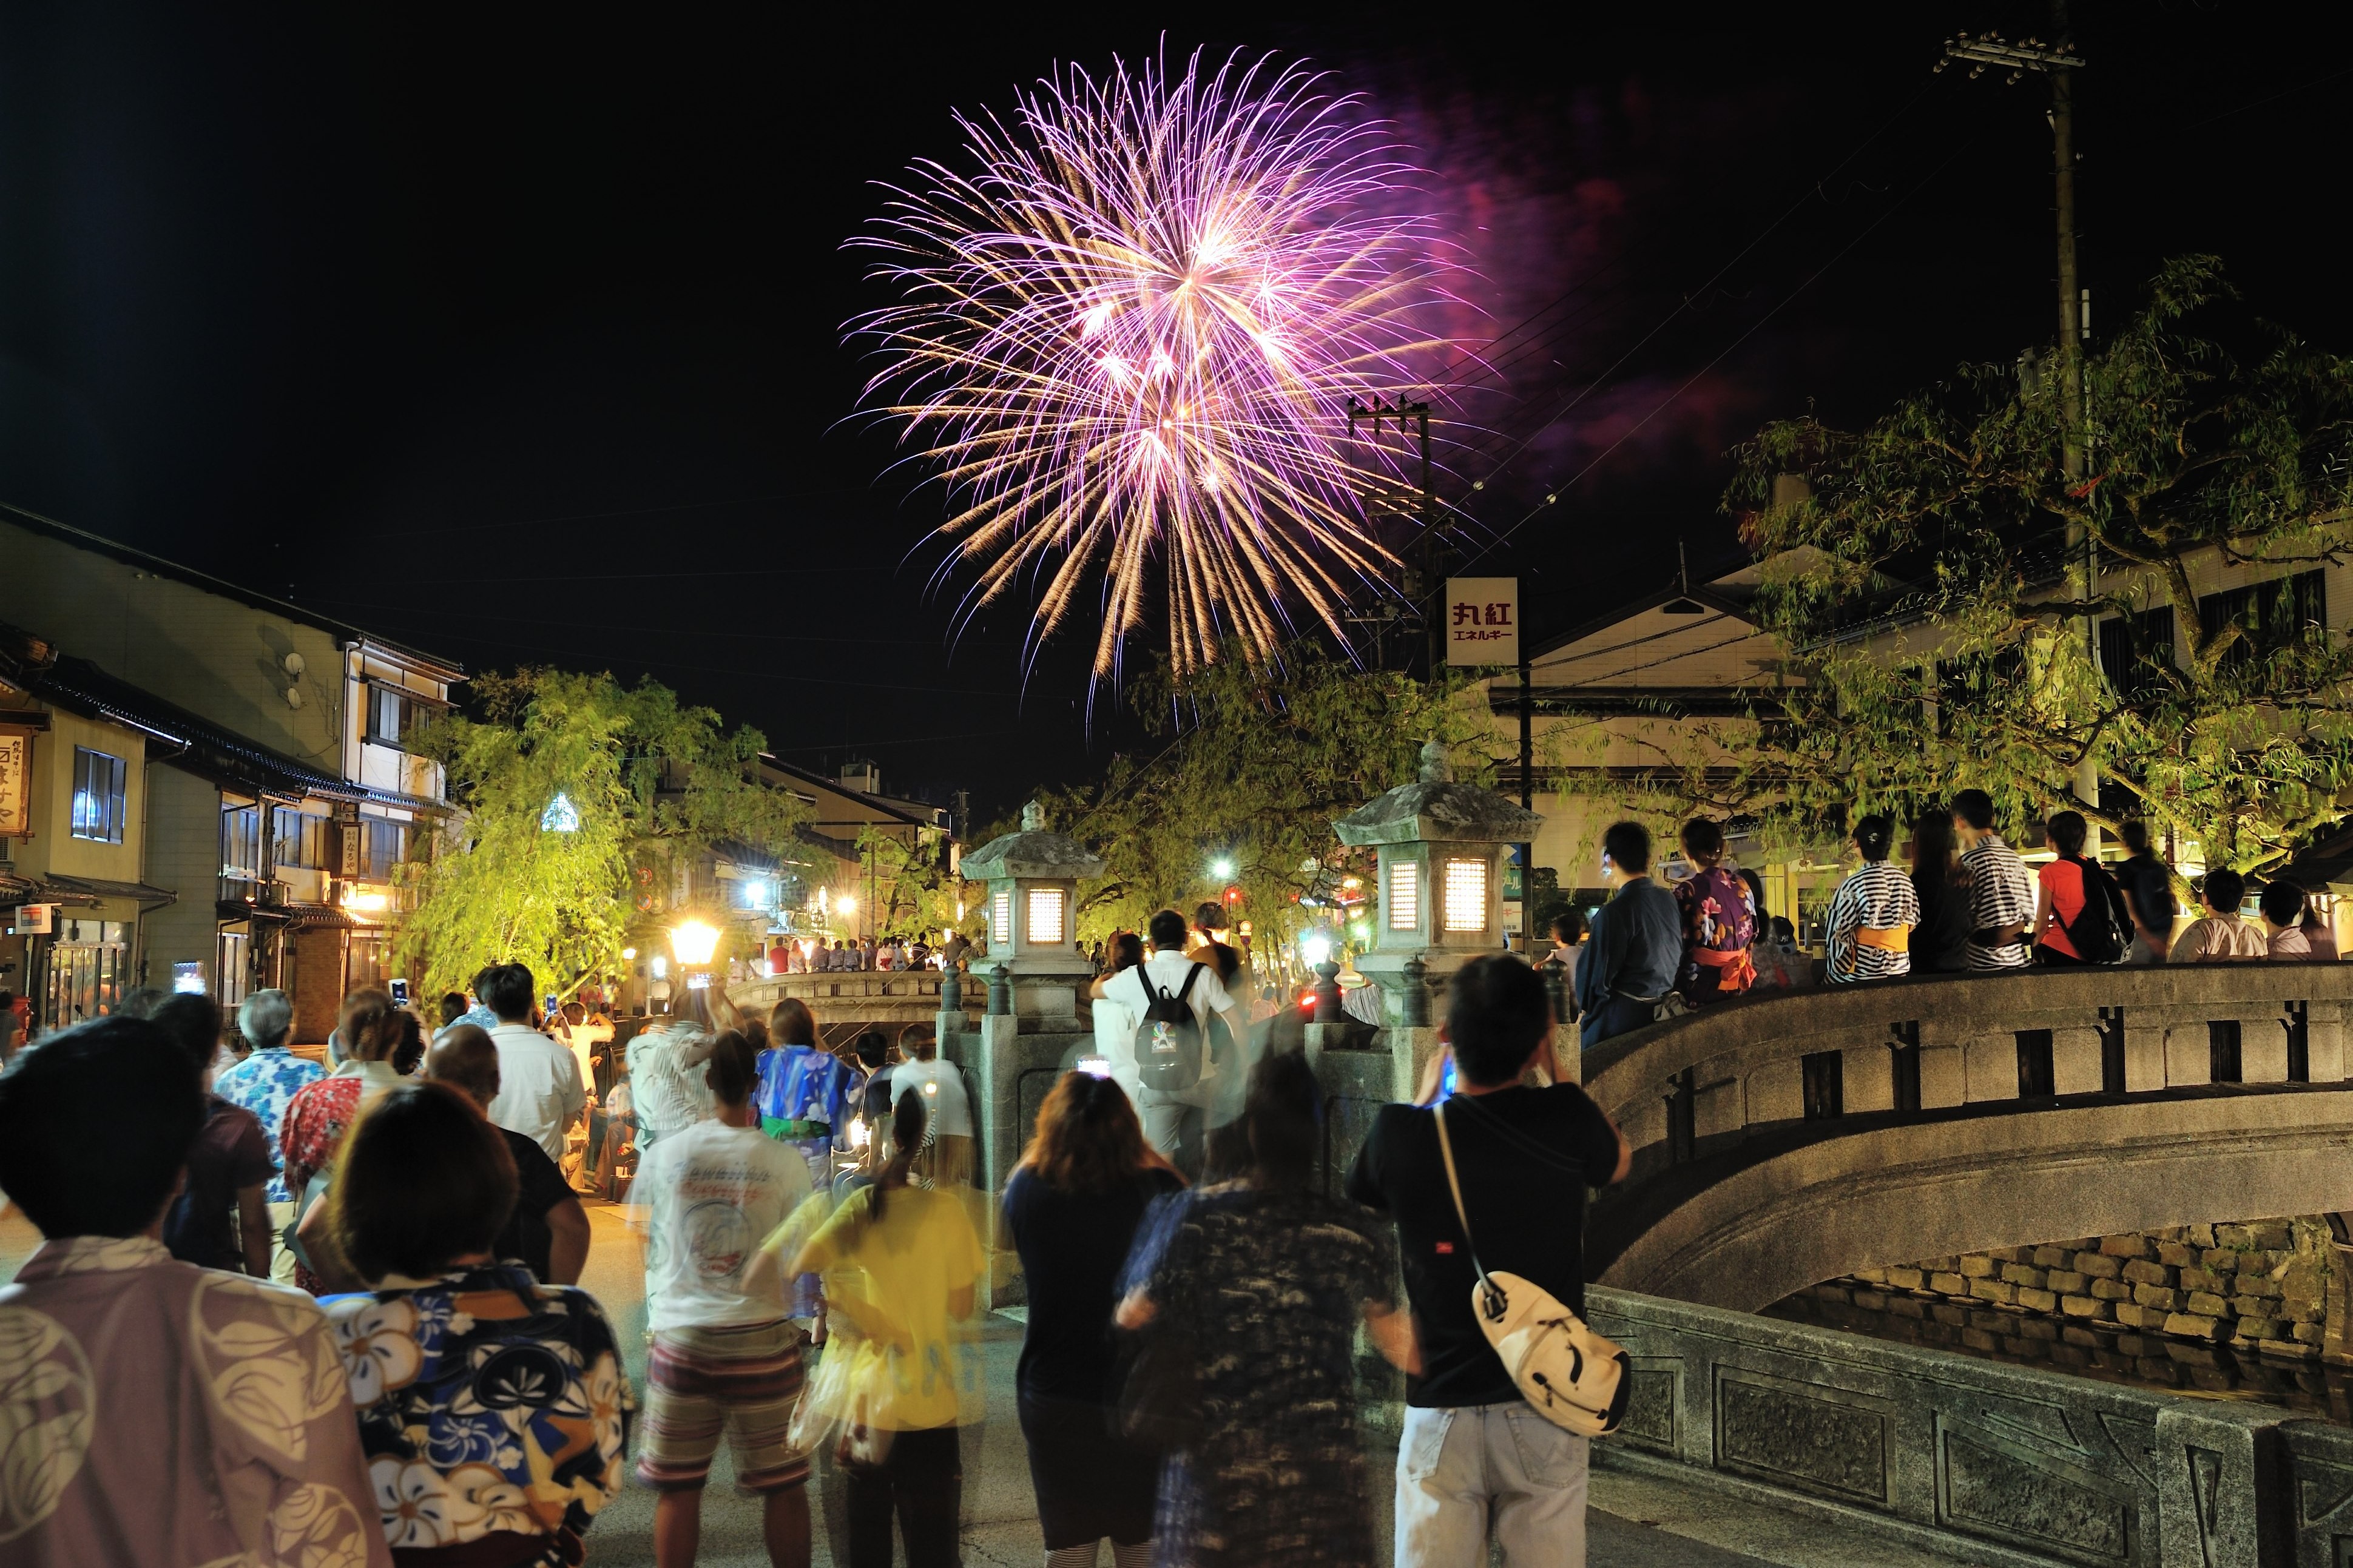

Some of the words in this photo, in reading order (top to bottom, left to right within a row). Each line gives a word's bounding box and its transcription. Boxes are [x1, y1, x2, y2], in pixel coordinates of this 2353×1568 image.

[1453, 602, 1512, 625] 丸紅
[1453, 630, 1512, 641] エネルギー
